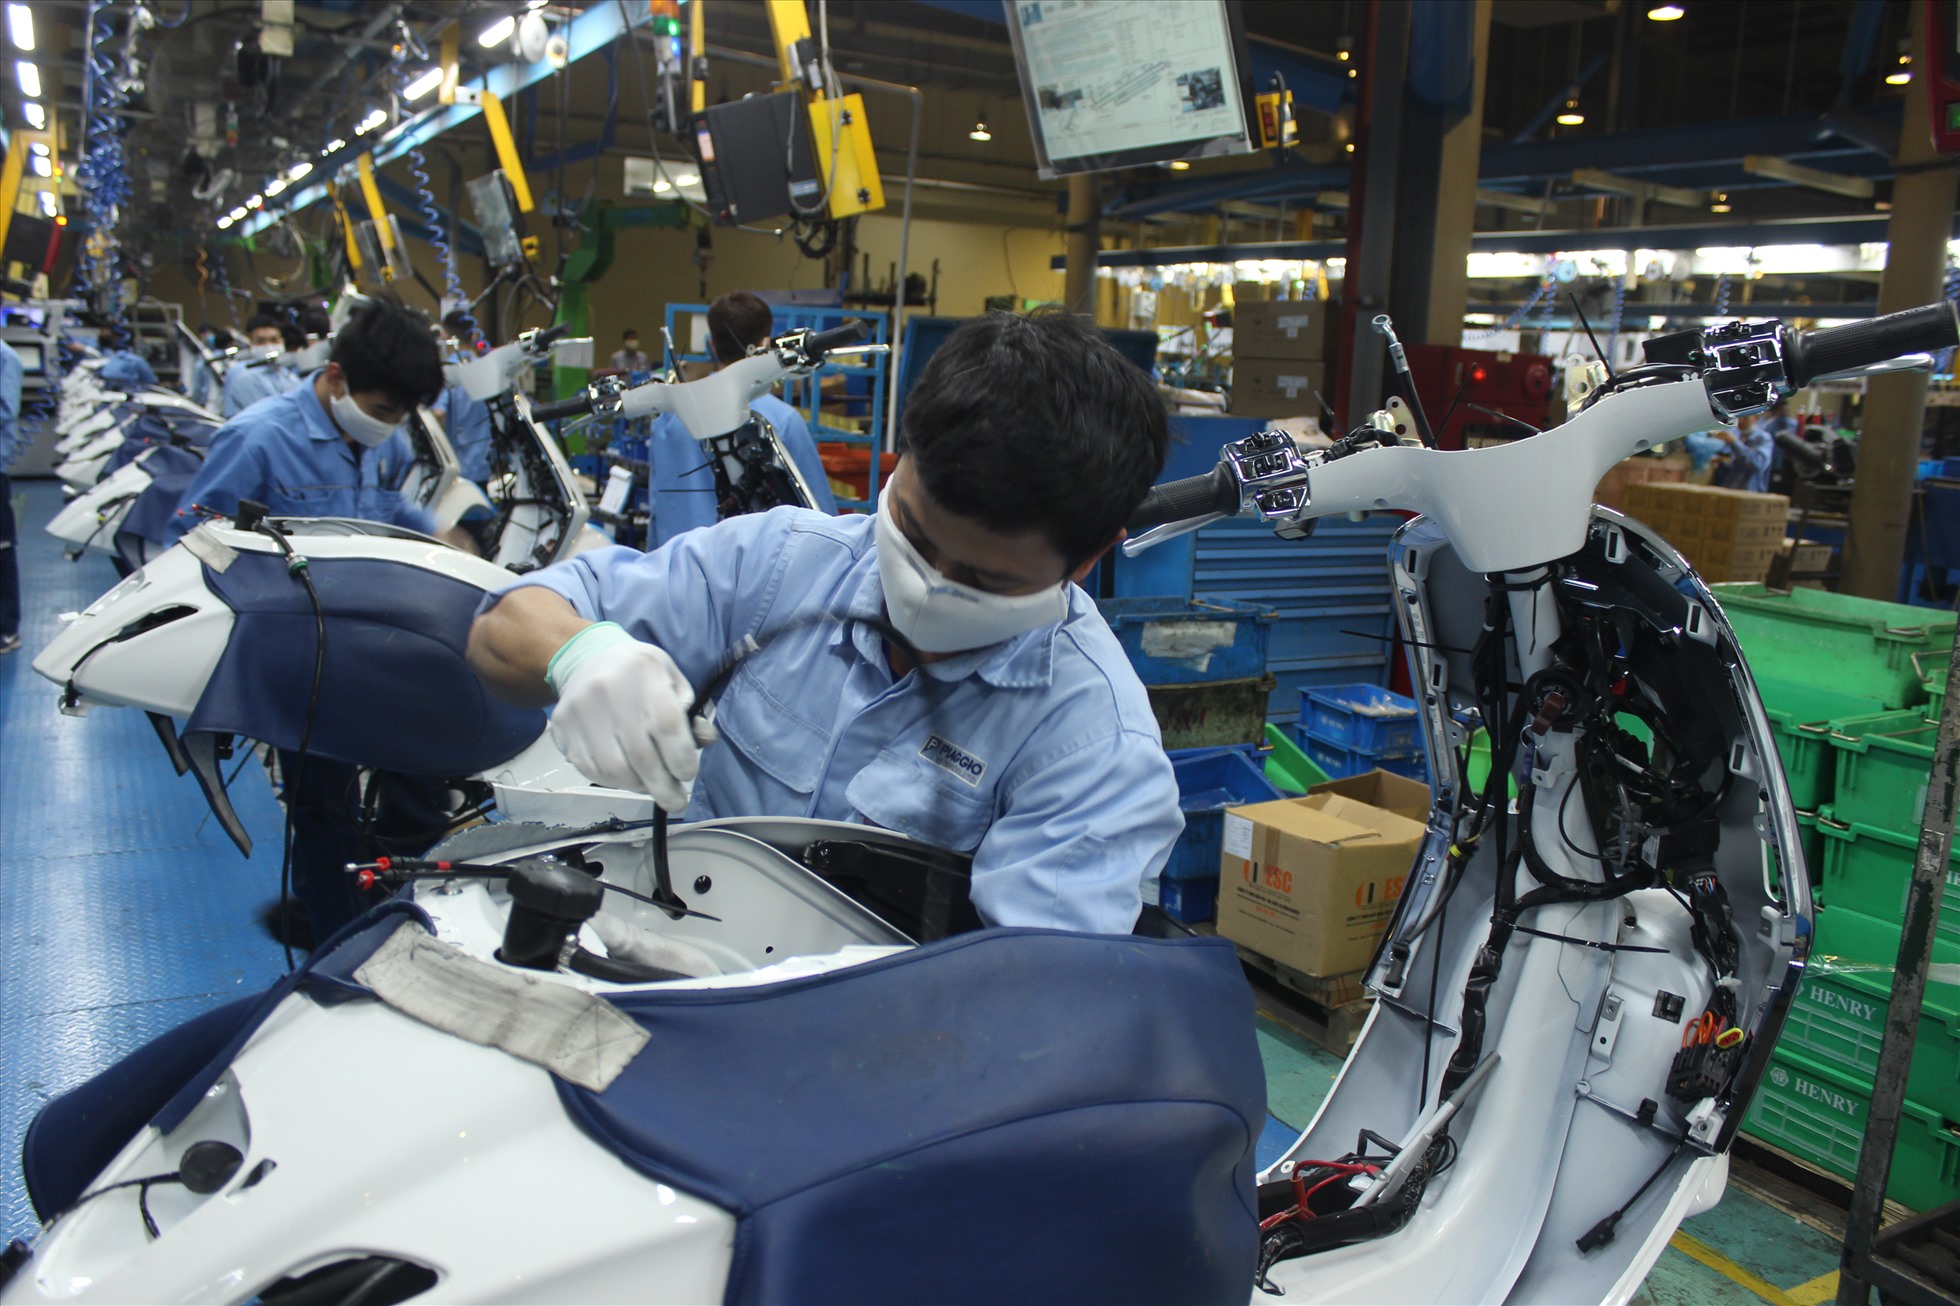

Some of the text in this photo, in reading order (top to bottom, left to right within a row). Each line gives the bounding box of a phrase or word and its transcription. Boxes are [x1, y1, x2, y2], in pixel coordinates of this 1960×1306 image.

[939, 744, 982, 775] PIAGGIO
[1266, 865, 1292, 893] ESC
[1384, 876, 1407, 899] ES
[1810, 985, 1879, 1021] HENRY
[1794, 1077, 1859, 1116] HENRY
